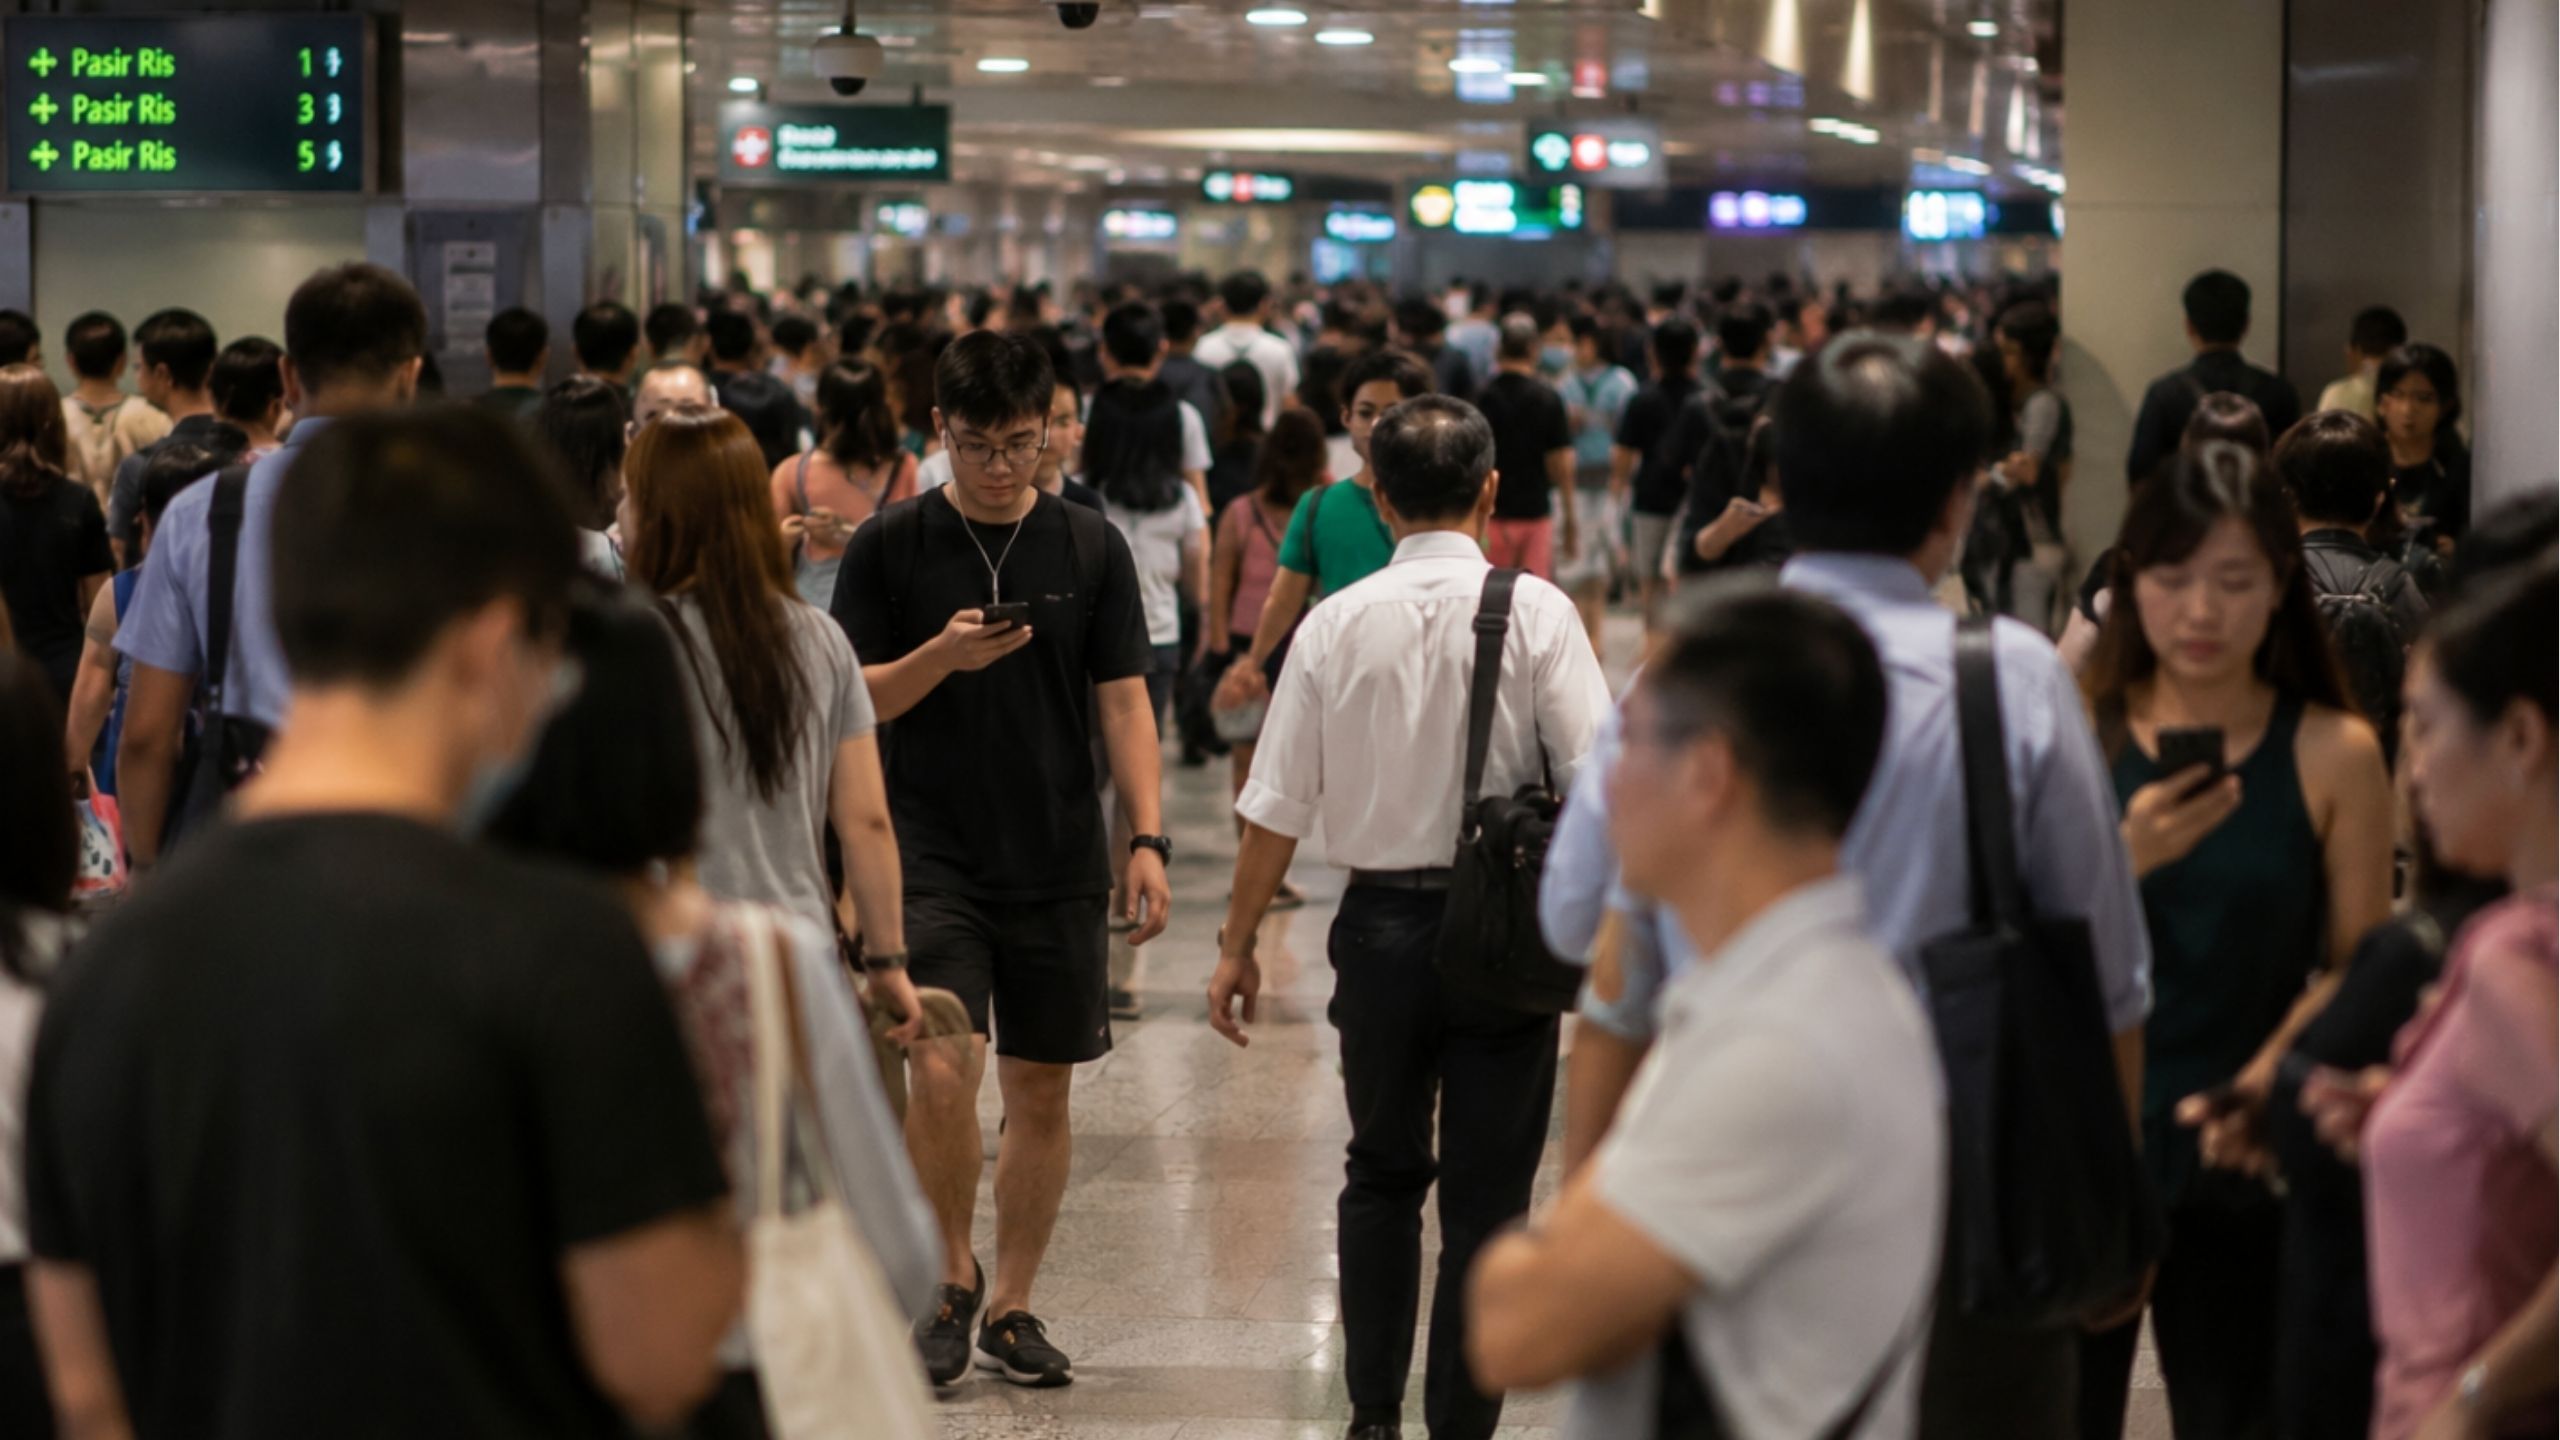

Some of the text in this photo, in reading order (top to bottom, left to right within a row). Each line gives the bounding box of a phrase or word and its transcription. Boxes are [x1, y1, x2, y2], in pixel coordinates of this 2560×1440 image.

[71, 47, 133, 77] Pasir
[137, 47, 175, 77] Ris
[299, 47, 312, 77] 1
[71, 93, 133, 124] Pasir
[137, 93, 175, 124] Ris
[298, 92, 315, 125] 3
[71, 140, 133, 171] Pasir
[137, 140, 175, 171] Ris
[298, 139, 316, 172] 5
